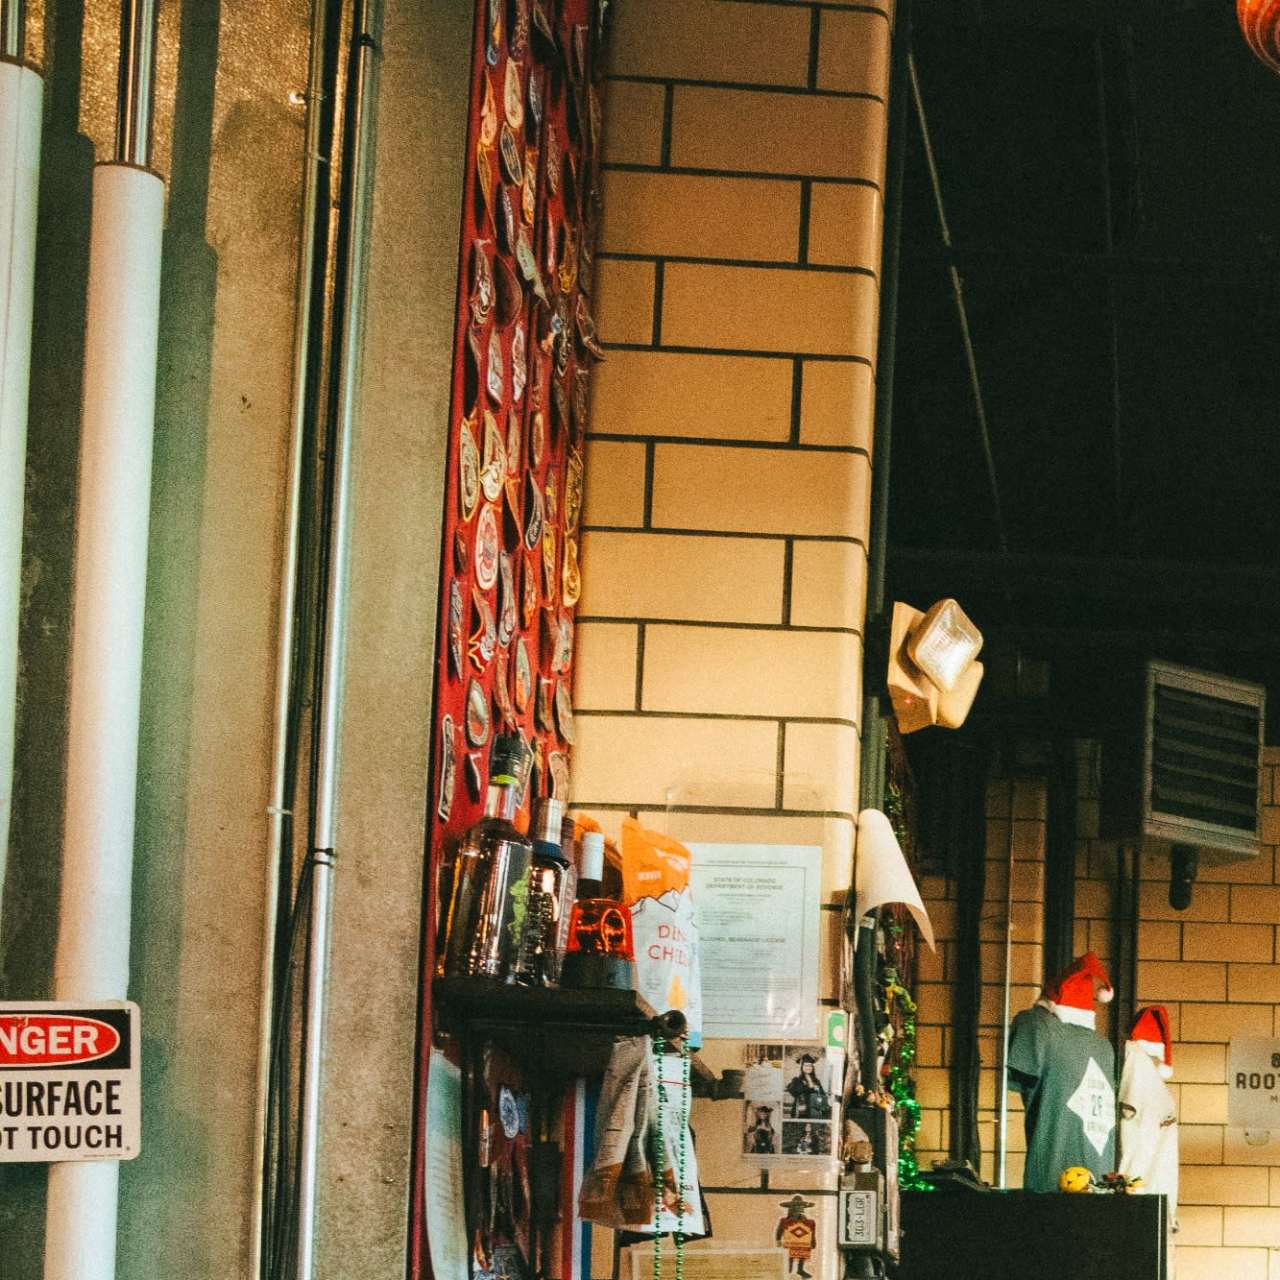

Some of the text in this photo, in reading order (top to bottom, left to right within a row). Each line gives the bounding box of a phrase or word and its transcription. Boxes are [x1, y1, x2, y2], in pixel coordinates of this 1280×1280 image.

[0, 1080, 121, 1117] URFACE
[0, 1125, 122, 1149] T TOUCH
